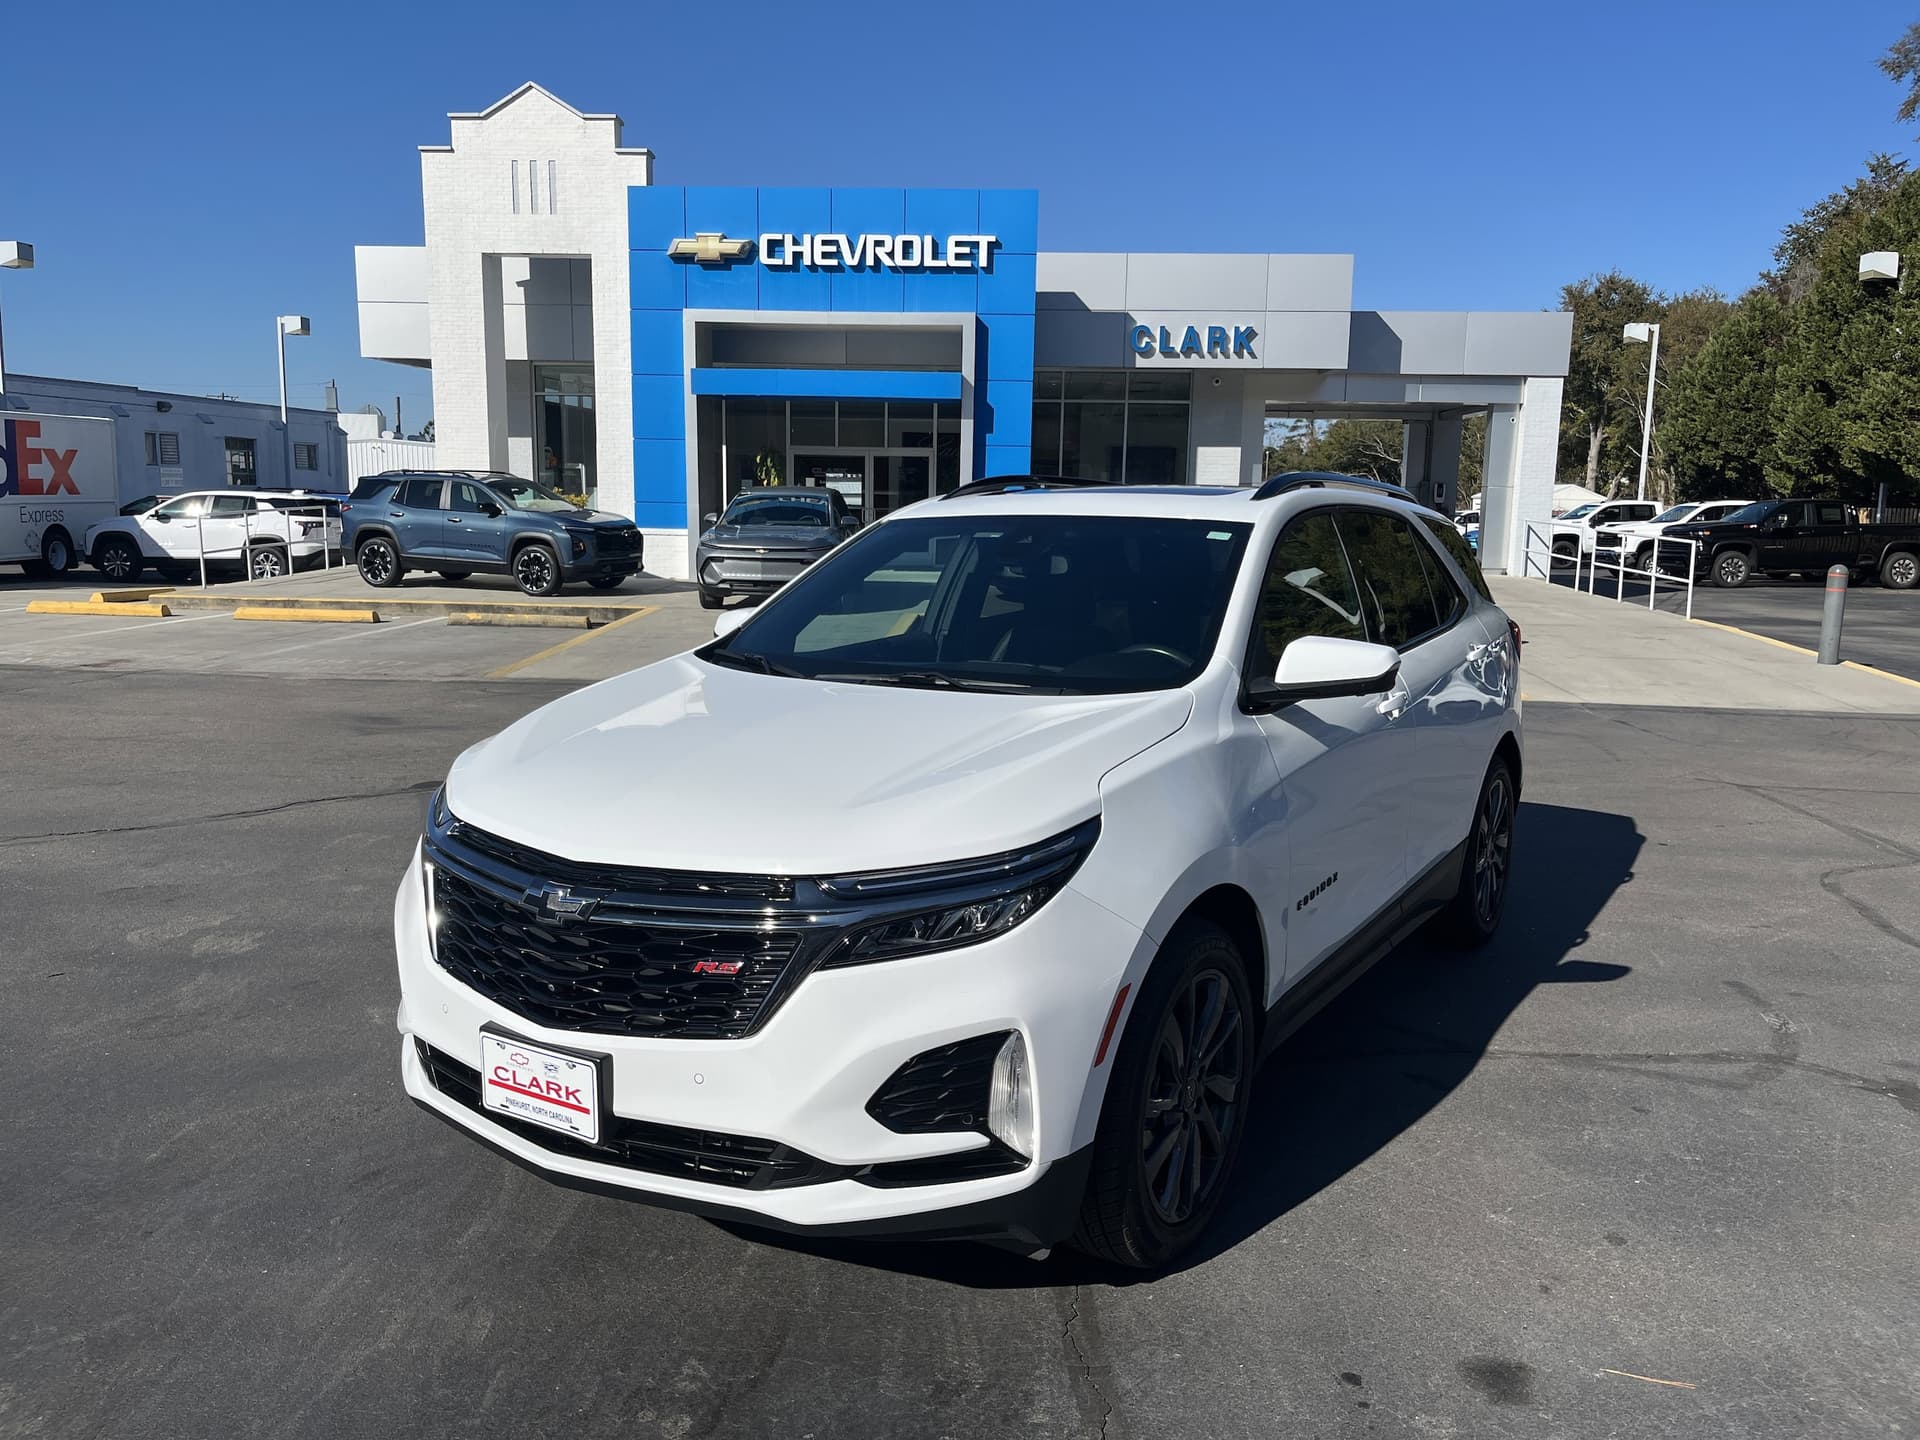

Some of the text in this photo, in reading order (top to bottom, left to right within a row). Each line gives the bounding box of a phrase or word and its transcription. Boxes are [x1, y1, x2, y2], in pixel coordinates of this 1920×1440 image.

[759, 233, 997, 269] CHEVROLET
[1131, 324, 1255, 354] CLARK
[20, 506, 65, 526] Express
[693, 961, 744, 975] RS
[494, 1066, 583, 1105] CLARK
[532, 1105, 548, 1117] NORTH
[549, 1110, 573, 1124] CAROLINA
